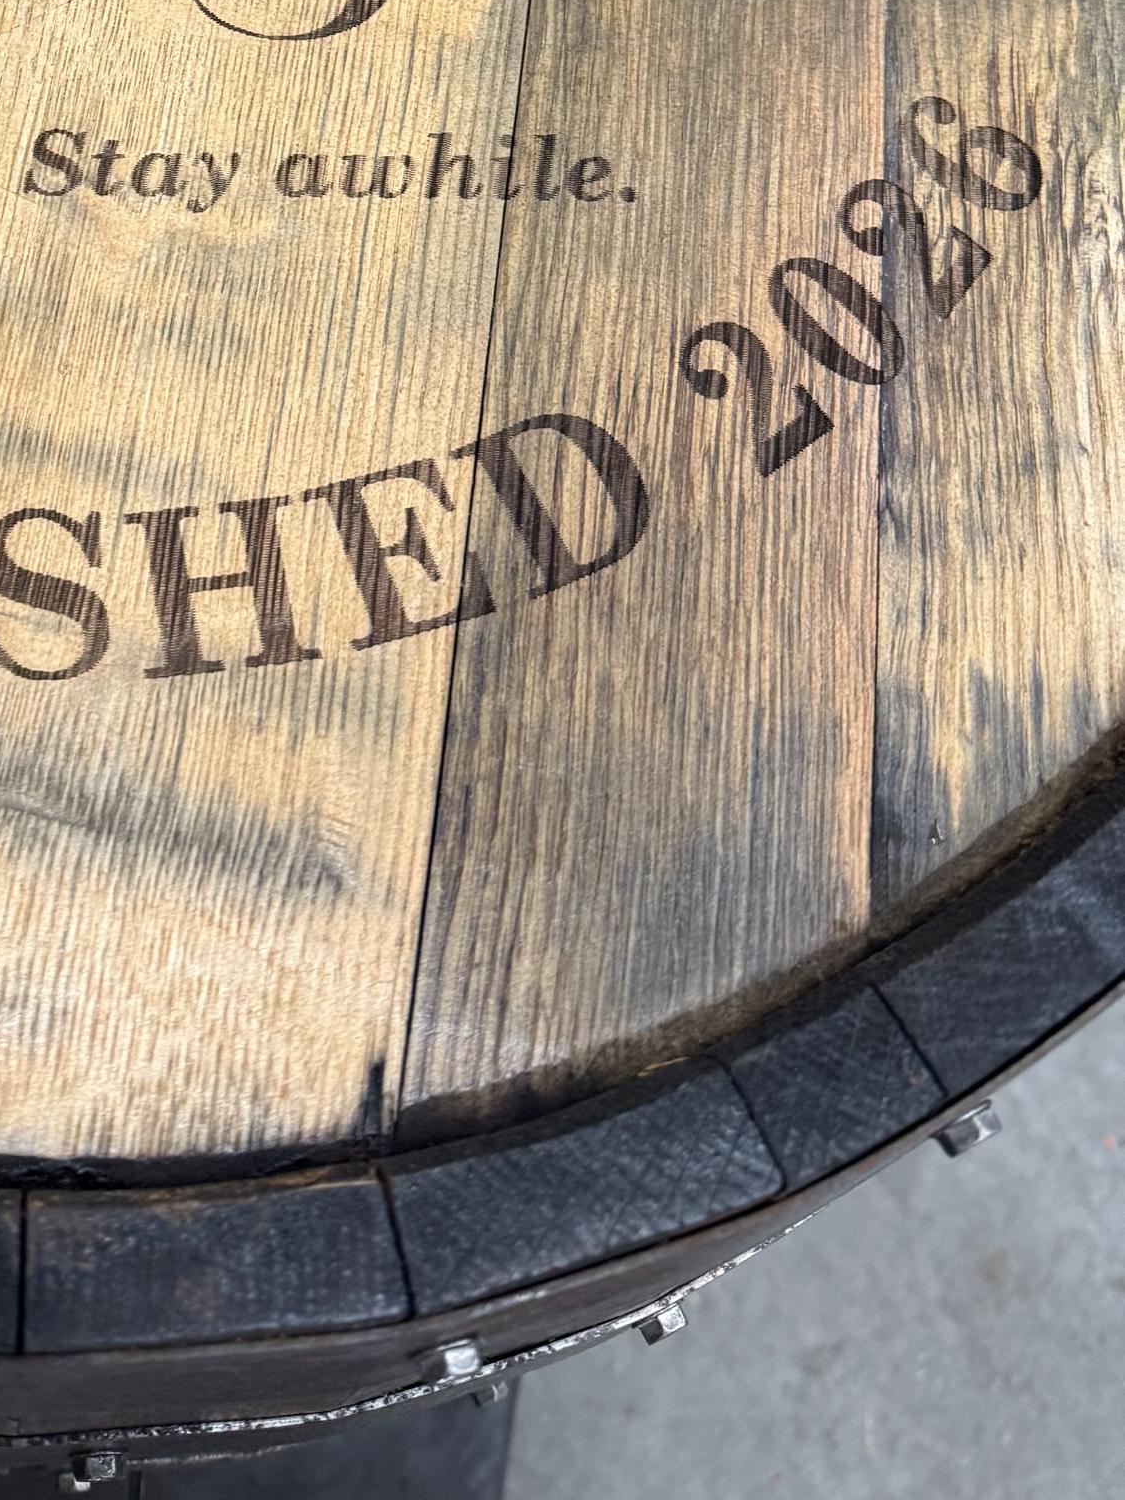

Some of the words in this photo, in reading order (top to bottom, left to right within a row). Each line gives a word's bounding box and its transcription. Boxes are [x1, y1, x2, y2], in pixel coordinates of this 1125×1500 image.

[23, 129, 241, 214] Stay
[275, 133, 639, 204] awhile.
[678, 96, 1043, 478] 2026
